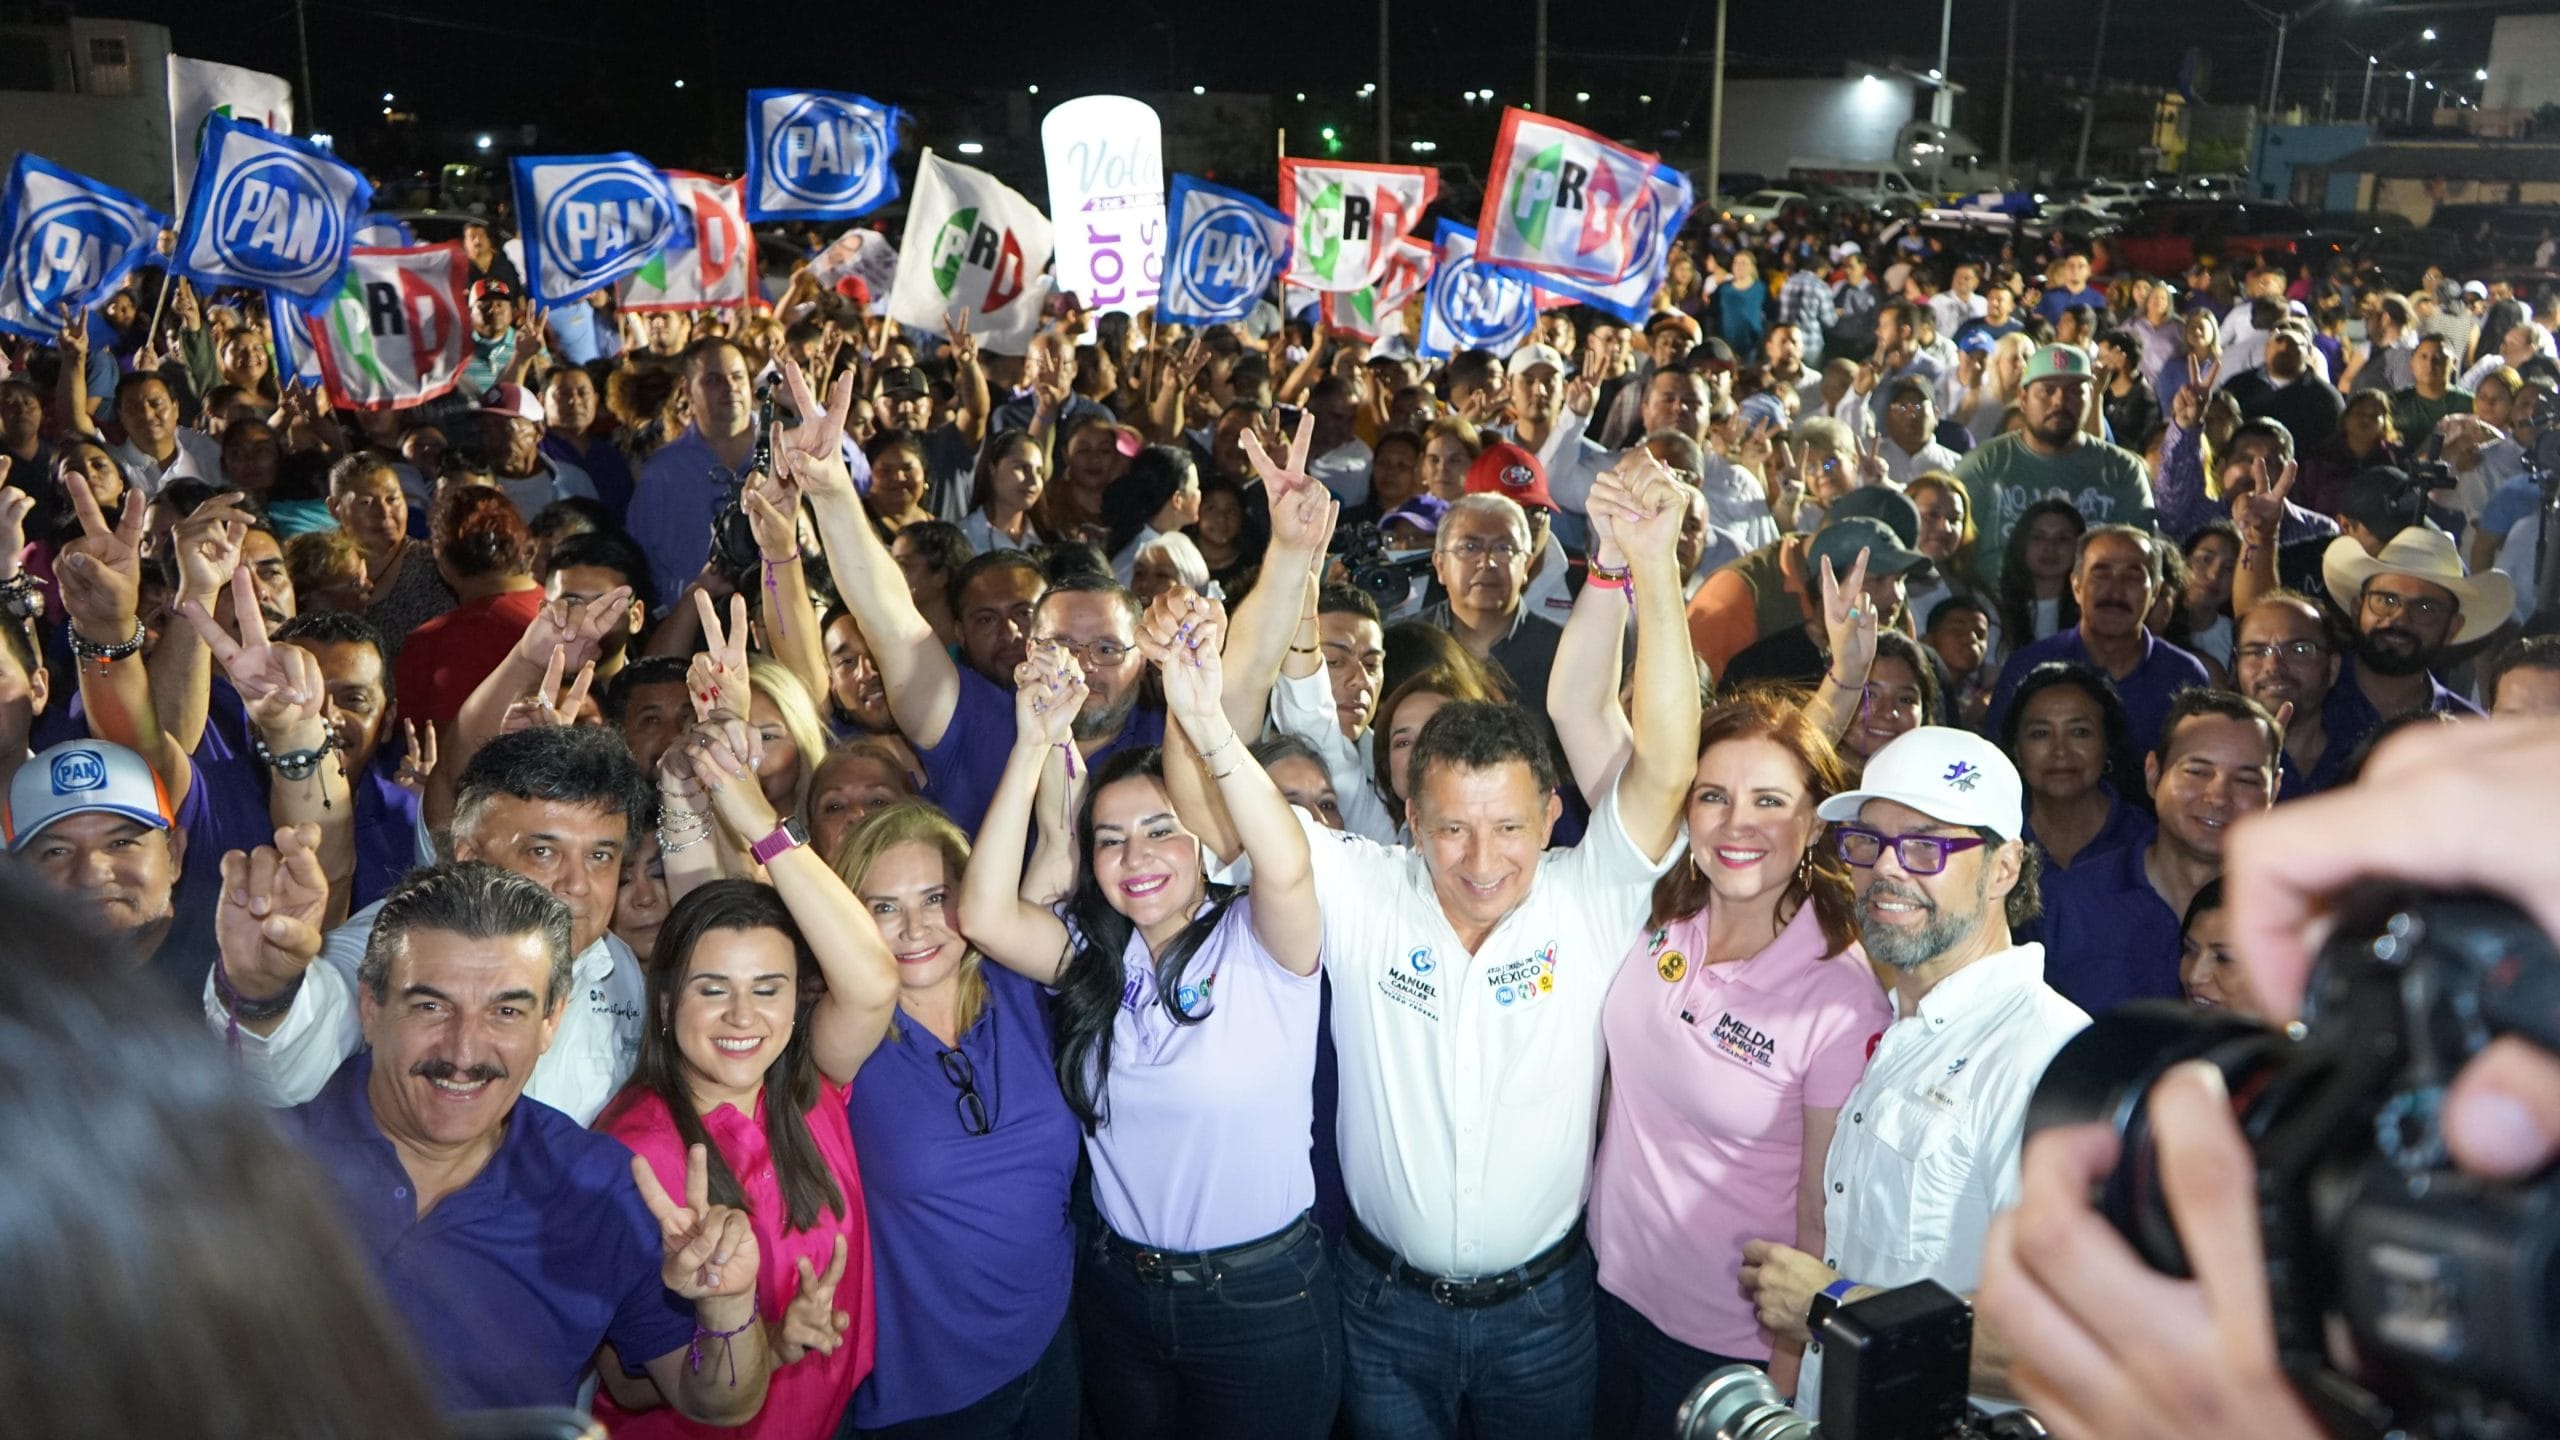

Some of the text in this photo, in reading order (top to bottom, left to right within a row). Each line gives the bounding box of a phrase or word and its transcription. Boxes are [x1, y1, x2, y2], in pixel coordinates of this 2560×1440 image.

[787, 121, 867, 177] PAN
[226, 178, 324, 260] PAN
[565, 197, 654, 262] PAN
[1087, 224, 1125, 306] tor
[60, 761, 97, 783] PAN
[1389, 967, 1437, 998] MANUEL
[1391, 980, 1428, 1001] CANALES
[1712, 1026, 1771, 1064] SANMIGUEL
[1719, 1012, 1775, 1054] IMELDA
